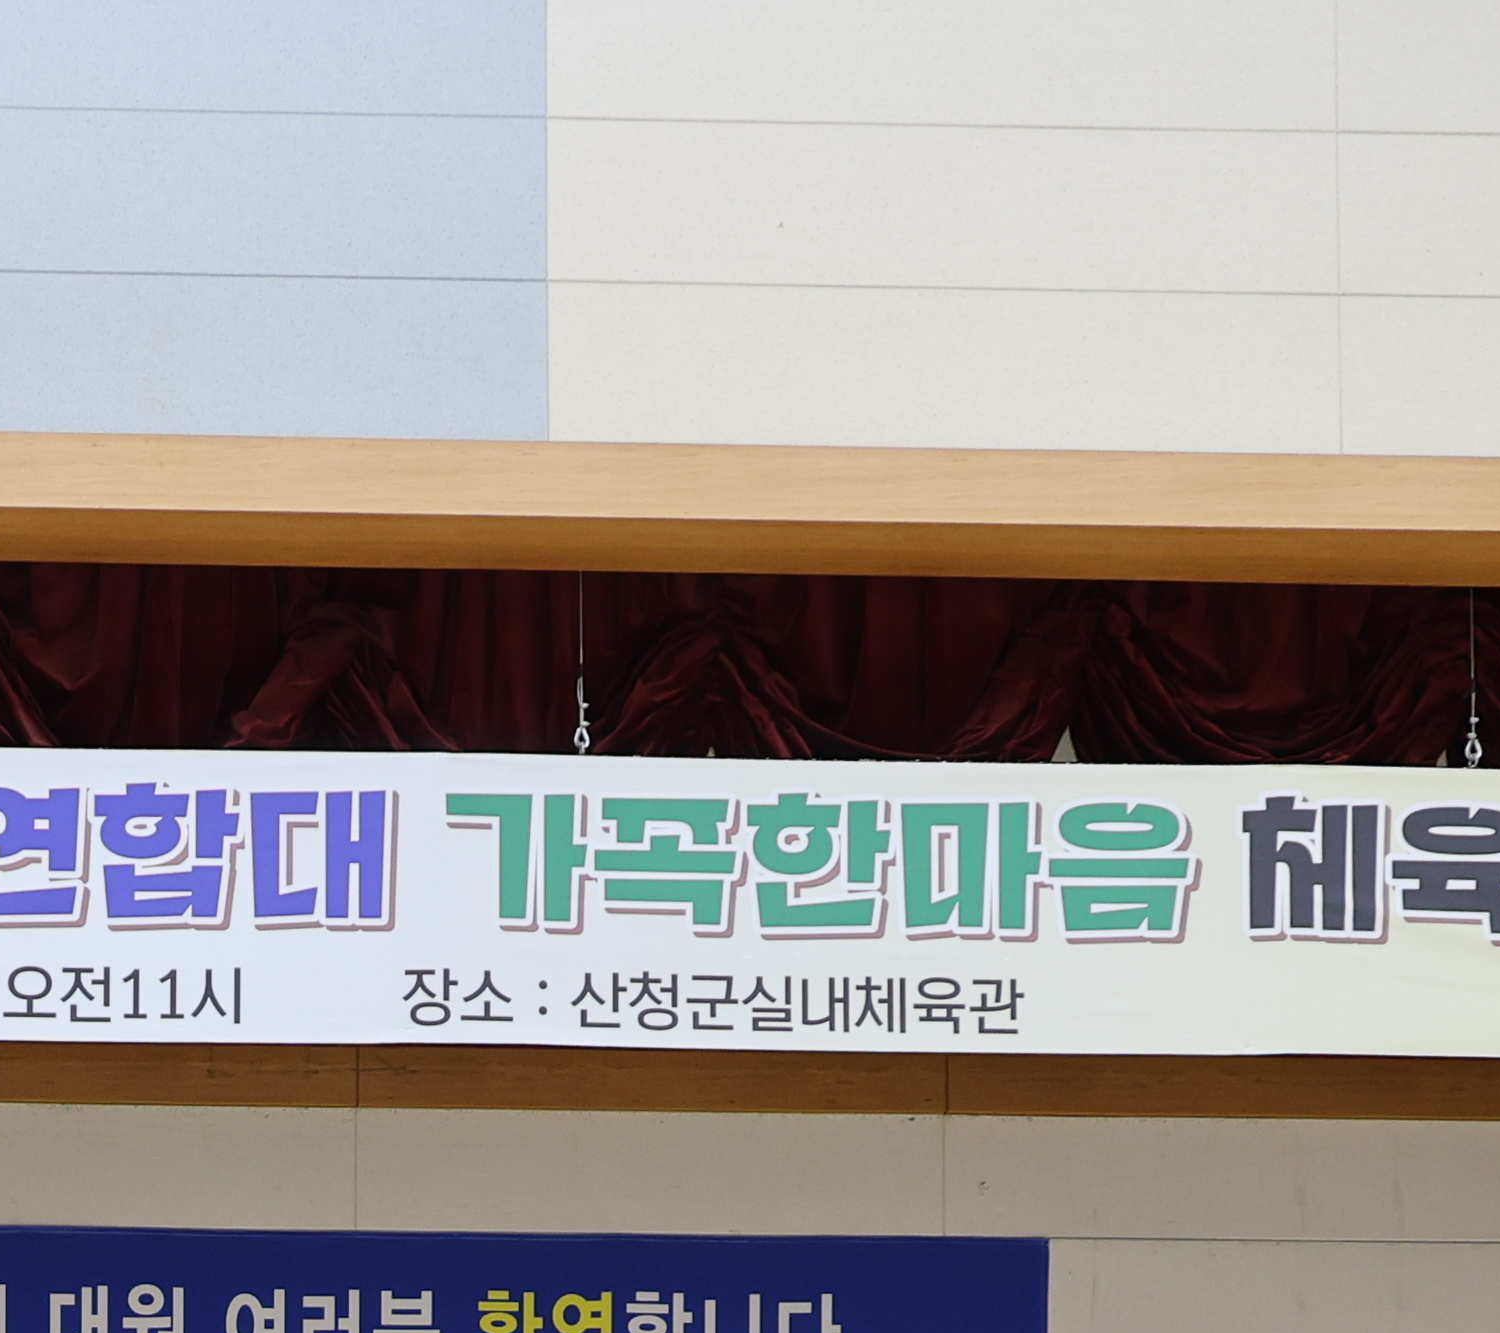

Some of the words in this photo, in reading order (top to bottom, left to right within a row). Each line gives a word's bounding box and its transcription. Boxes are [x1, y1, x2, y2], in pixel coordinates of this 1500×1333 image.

[446, 793, 1190, 932] 가족한마음
[3, 967, 242, 1025] 오전11시
[402, 968, 515, 1028] 장소
[571, 972, 1026, 1036] 산청군실내체육관
